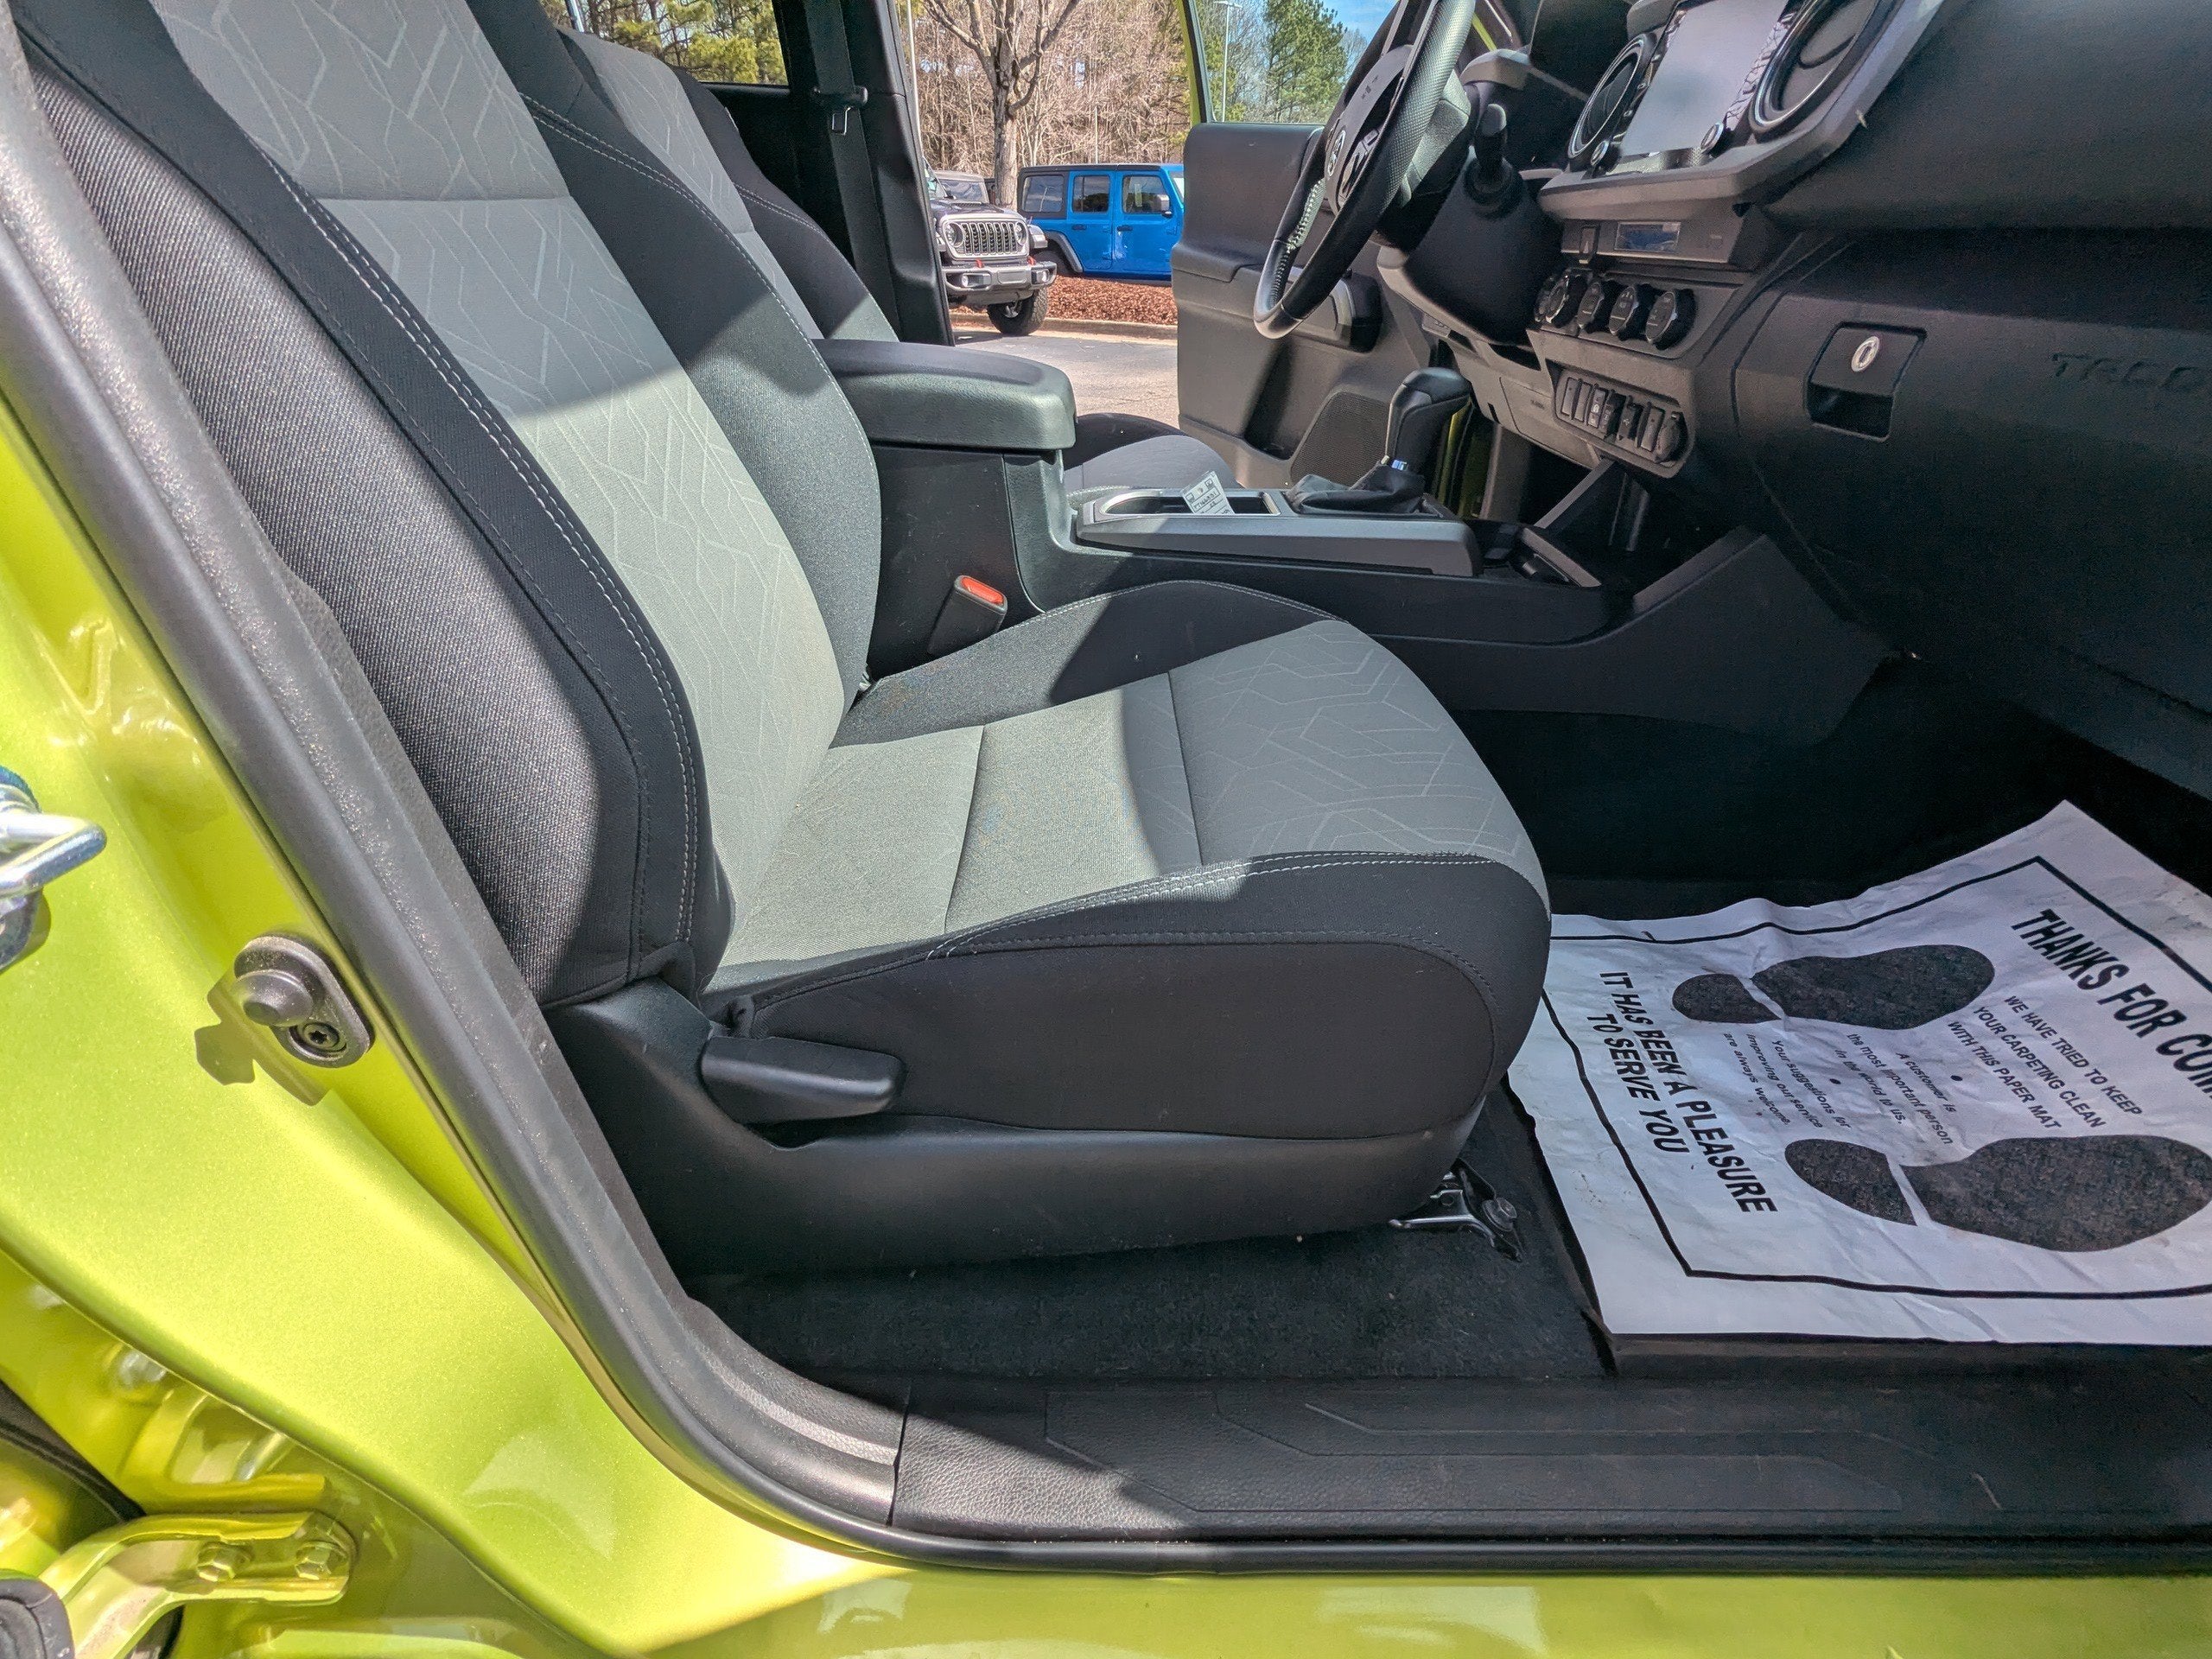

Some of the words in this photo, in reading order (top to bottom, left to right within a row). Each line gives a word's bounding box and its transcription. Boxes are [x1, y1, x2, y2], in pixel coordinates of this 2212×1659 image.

[1599, 971, 1634, 988] IT
[2011, 909, 2130, 990] THANKS
[2096, 983, 2187, 1038] FOR
[1586, 1013, 1624, 1033] TO
[1611, 993, 1654, 1026] HAS
[1604, 1037, 1662, 1102] SERVE
[1633, 1029, 1687, 1077] BEEN
[1663, 1080, 1698, 1096] A
[1723, 1033, 1738, 1047] are
[1733, 1050, 1759, 1084] always
[1745, 1033, 1780, 1081] improving
[1777, 1083, 1796, 1099] our
[1789, 1098, 1823, 1128] service
[1771, 1039, 1791, 1063] Your
[1786, 1062, 1836, 1115] suggestions
[1832, 1116, 1852, 1128] for
[1834, 1049, 1847, 1059] in
[1843, 1061, 1861, 1071] the
[1859, 1072, 1887, 1096] world
[1878, 1098, 1894, 1107] to
[1890, 1108, 1907, 1124] us.
[1896, 1052, 1910, 1060] A
[1904, 1060, 1948, 1102] customer
[1943, 1103, 1957, 1113] is
[1948, 1021, 1978, 1046] WITH
[1972, 1046, 2000, 1067] THIS
[1993, 1067, 2035, 1103] PAPER
[2028, 1104, 2063, 1129] MAT
[1974, 1006, 2006, 1035] YOUR
[2001, 1034, 2065, 1090] CARPETING
[2059, 1090, 2107, 1128] CLEAN
[2004, 995, 2029, 1014] WE
[2021, 1013, 2057, 1039] HAVE
[2051, 1038, 2089, 1068] TRIED
[2084, 1068, 2107, 1085] TO
[2101, 1085, 2143, 1116] KEEP
[1847, 1033, 1864, 1046] the
[1860, 1046, 1887, 1069] most
[1880, 1069, 1927, 1108] important
[1916, 1109, 1954, 1145] person
[1638, 1109, 1690, 1154] YOU
[1675, 1100, 1778, 1213] PLEASURE
